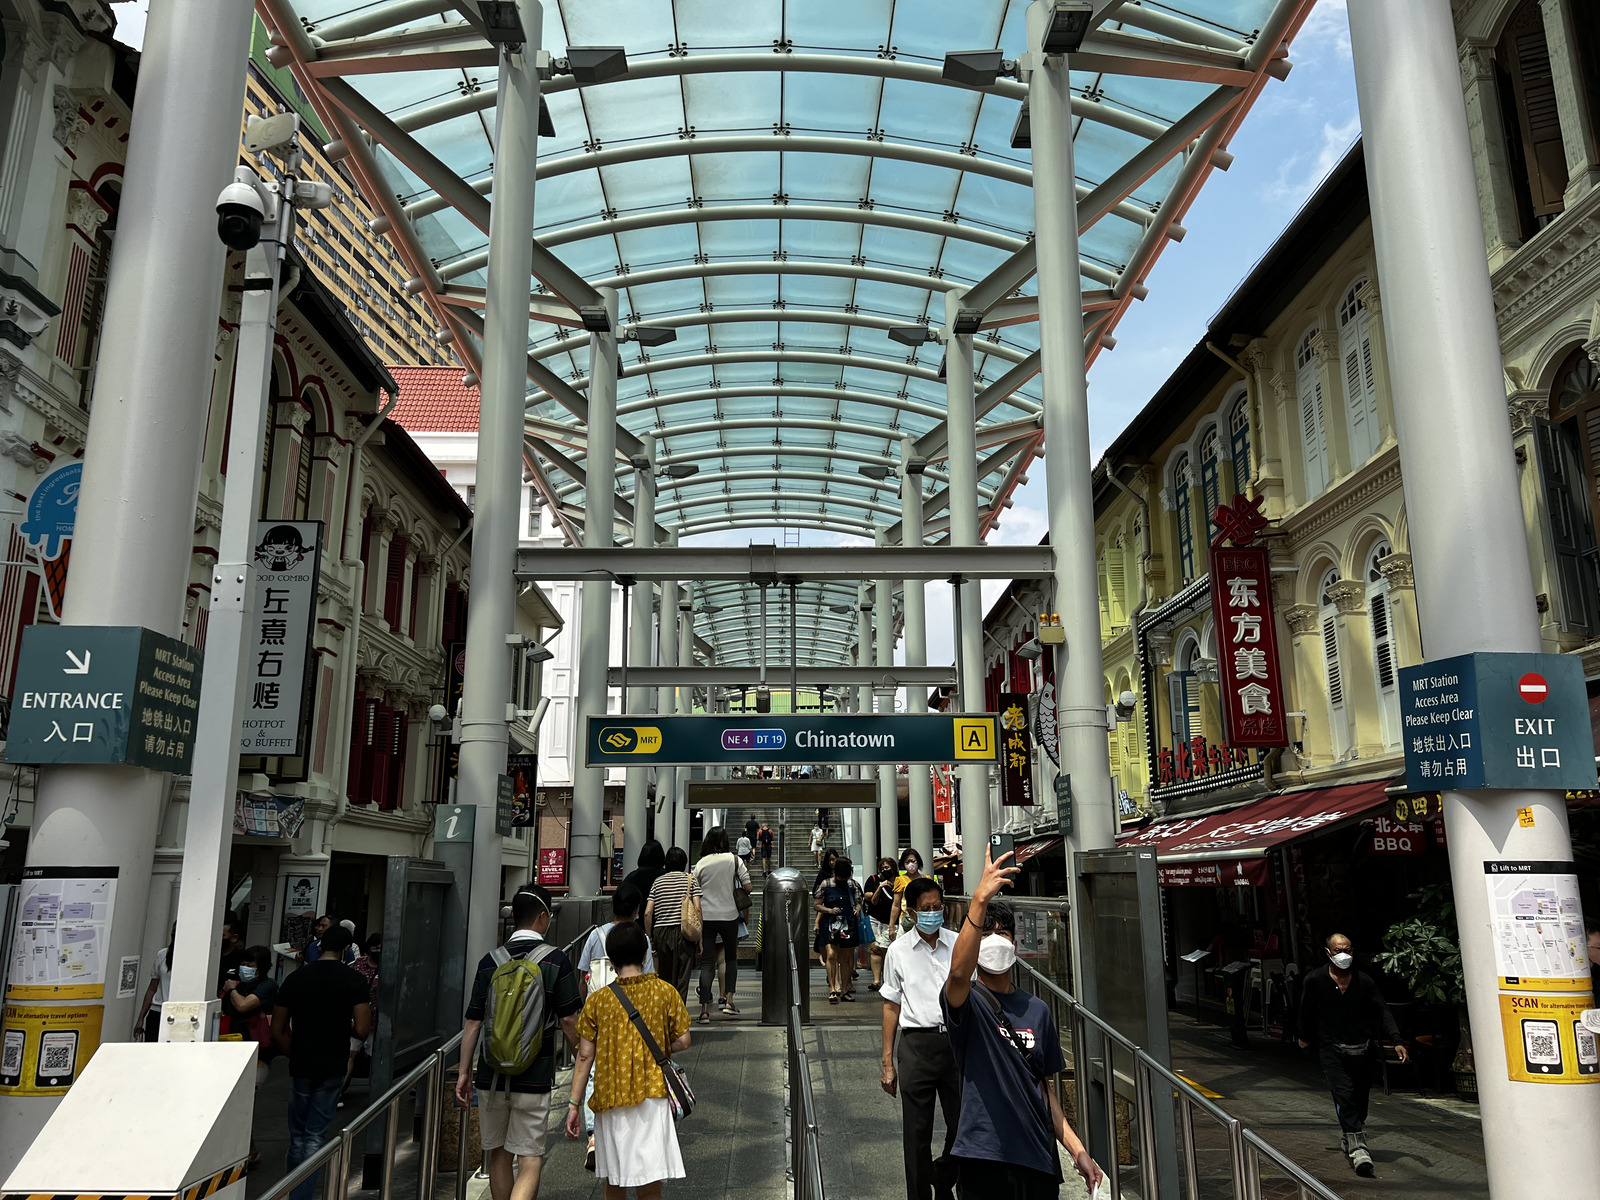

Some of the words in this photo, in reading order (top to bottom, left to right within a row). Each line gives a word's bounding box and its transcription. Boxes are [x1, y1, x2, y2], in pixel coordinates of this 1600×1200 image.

[1223, 557, 1257, 572] BBQ
[256, 574, 275, 582] OOD
[277, 574, 310, 582] COMBO
[252, 587, 290, 710] 左煮右烤
[1226, 576, 1273, 716] 东方美食
[155, 648, 172, 665] MRT
[172, 654, 195, 673] Station
[153, 667, 176, 684] Access
[176, 675, 191, 689] Area
[1412, 679, 1429, 692] MRT
[1430, 675, 1459, 689] Station
[22, 692, 123, 709] ENTRANCE
[139, 681, 164, 698] Please
[164, 688, 181, 706] Keep
[182, 694, 198, 709] Clear
[1415, 696, 1439, 708] Access
[1441, 693, 1459, 704] Area
[141, 707, 191, 735] 地铁出入口
[242, 719, 285, 729] HOTPOT
[1239, 716, 1277, 737] 烧烤
[1405, 713, 1429, 727] Please
[1430, 712, 1450, 725] Keep
[1452, 708, 1473, 721] Clear
[43, 720, 94, 743] 入口
[257, 729, 266, 737] &
[1515, 718, 1556, 736] EXIT
[144, 734, 185, 759] 请勿占用
[255, 738, 293, 747] BUFFET
[640, 736, 658, 744] MRT
[728, 736, 740, 744] NE
[742, 735, 749, 744] 4
[756, 736, 768, 744] DT
[772, 735, 782, 744] 19
[795, 729, 895, 748] Chinatown
[968, 730, 981, 747] A
[1003, 703, 1028, 777] 老成都
[1413, 732, 1471, 754] 地铁出入口
[1516, 745, 1561, 769] 出口
[1420, 758, 1467, 777] 请勿占用
[1374, 837, 1412, 852] BBQ
[1511, 997, 1538, 1009] SCAN
[67, 1012, 88, 1020] options
